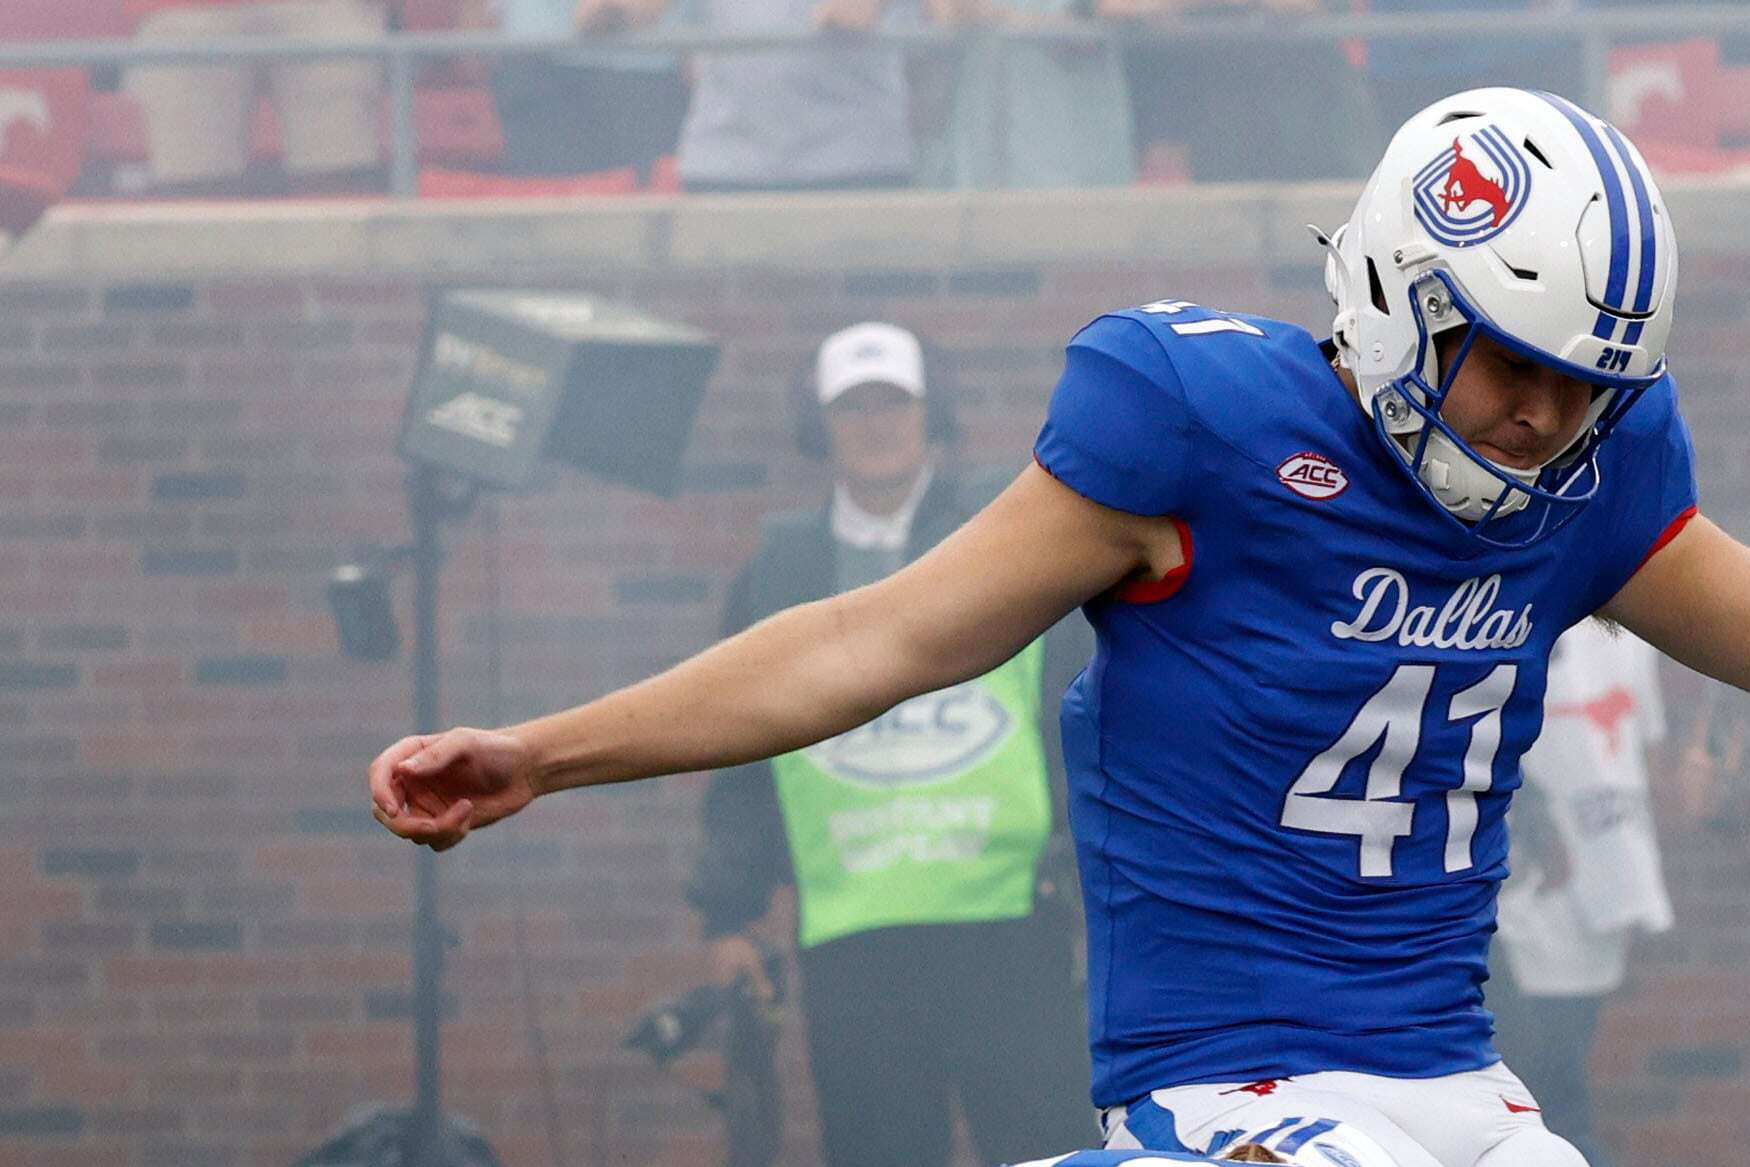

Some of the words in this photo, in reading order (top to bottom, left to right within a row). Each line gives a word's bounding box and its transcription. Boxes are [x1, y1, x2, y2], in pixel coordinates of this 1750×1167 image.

[1288, 463, 1340, 485] ACC
[1331, 567, 1533, 650] Dallas
[1280, 664, 1517, 877] 41
